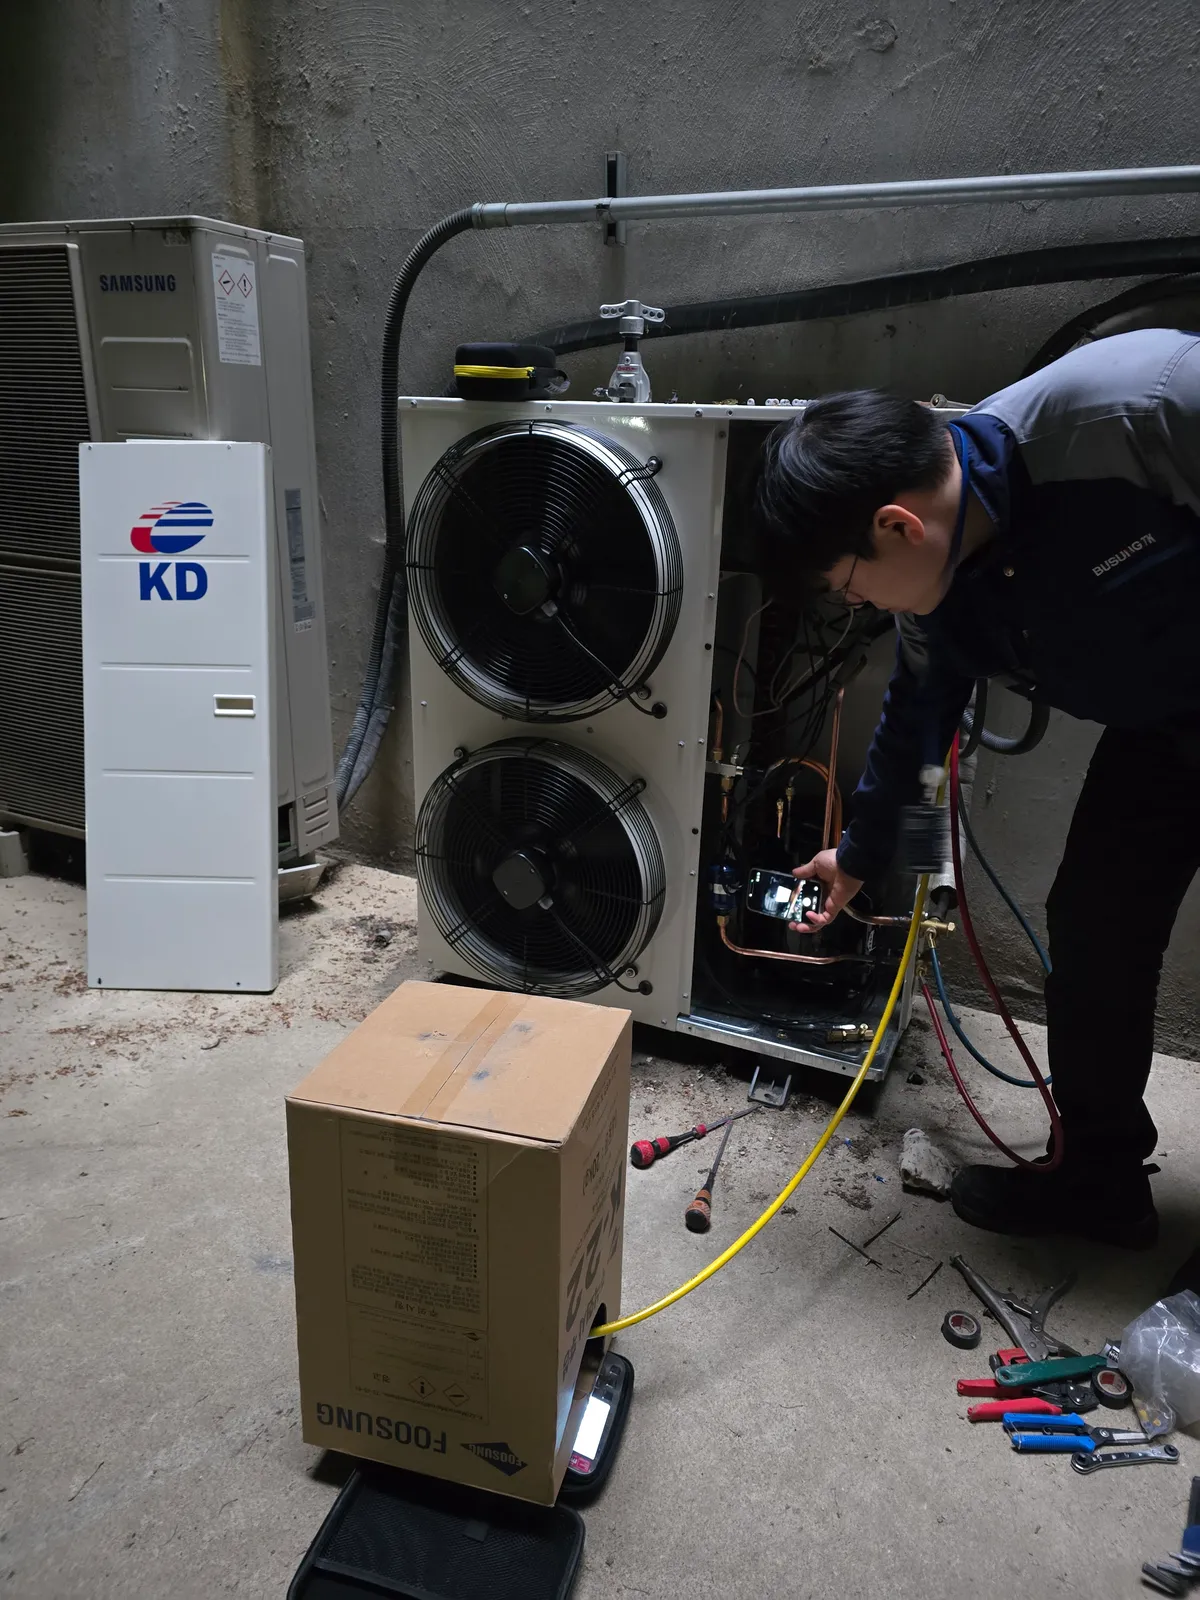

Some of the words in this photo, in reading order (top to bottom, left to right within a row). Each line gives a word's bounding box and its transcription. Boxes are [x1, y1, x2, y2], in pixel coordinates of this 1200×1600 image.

[99, 274, 177, 293] SAMSUNG
[139, 561, 209, 601] KD
[315, 1401, 447, 1455] FOOSUNG
[468, 1444, 522, 1467] FOOSUNG
